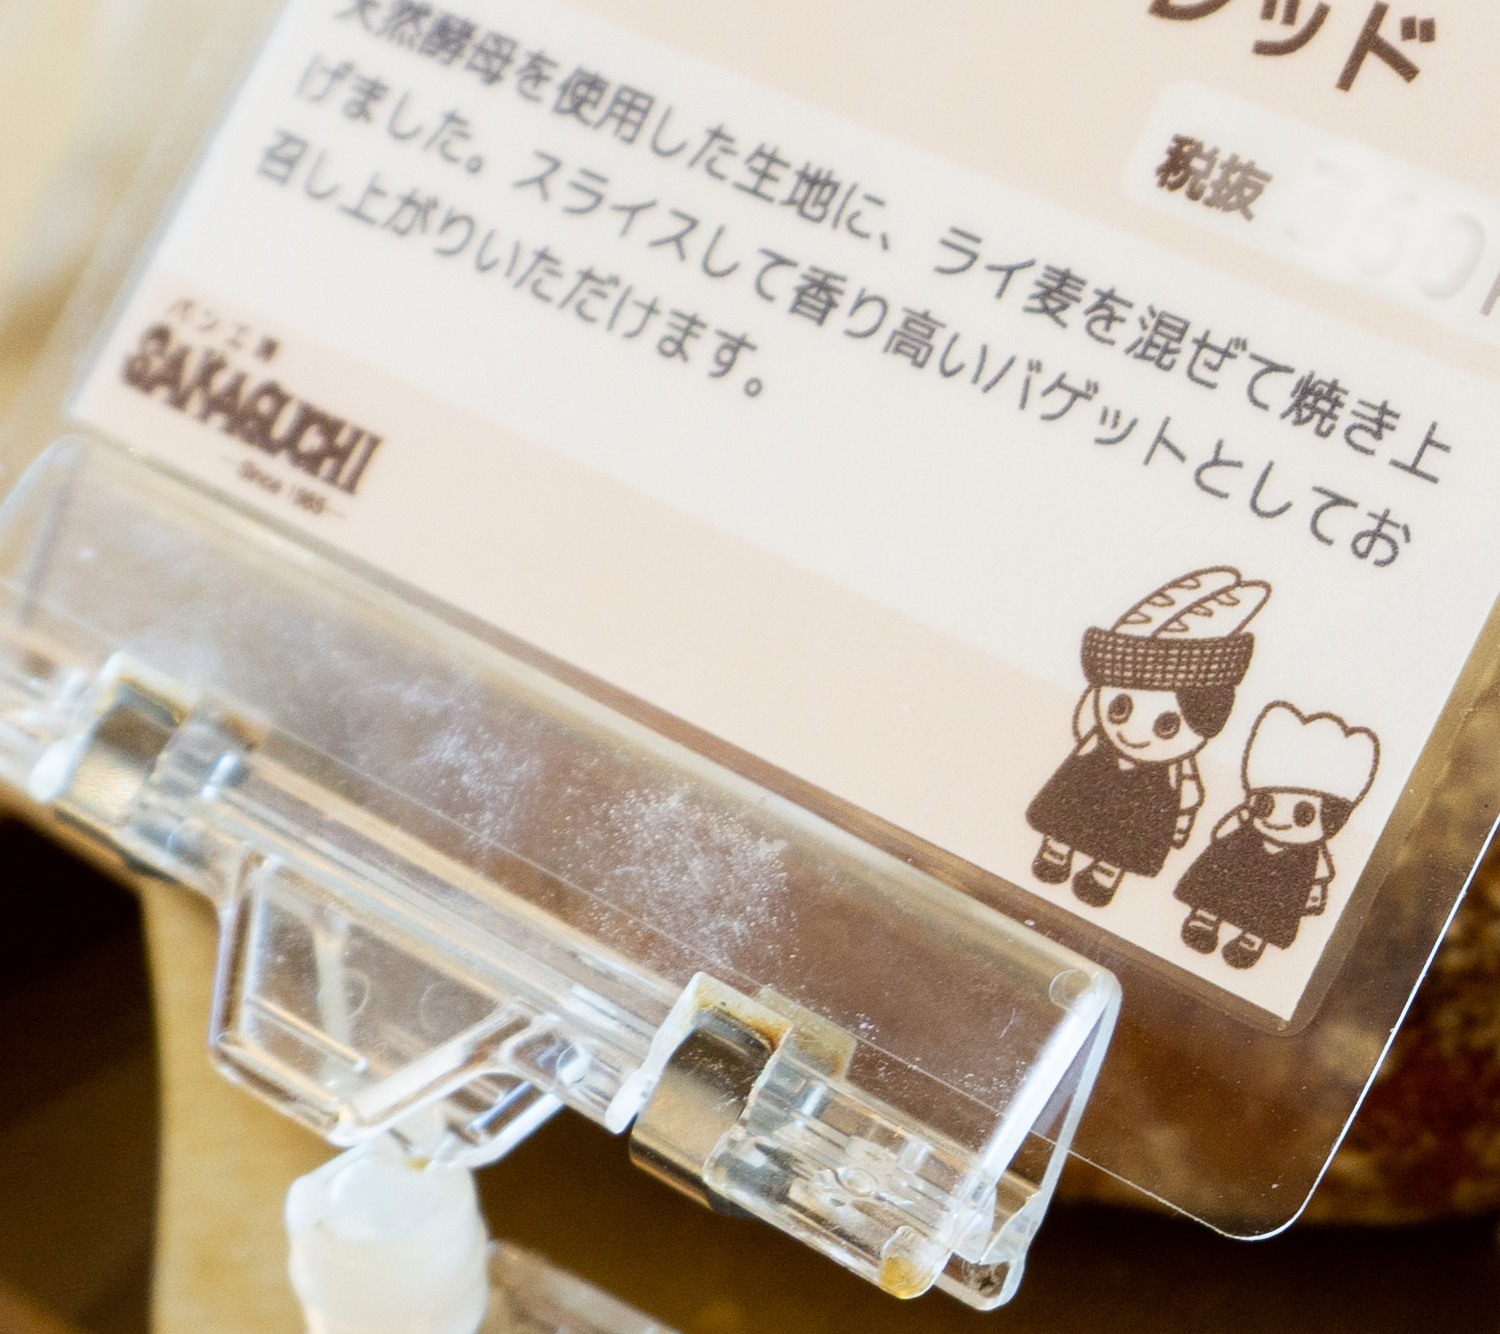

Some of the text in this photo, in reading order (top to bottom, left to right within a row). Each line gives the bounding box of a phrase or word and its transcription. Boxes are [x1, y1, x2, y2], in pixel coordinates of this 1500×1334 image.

[256, 128, 764, 399] 召し上がりいただけます。
[296, 52, 1412, 568] げました。スライスして香り高いバゲットとしてお
